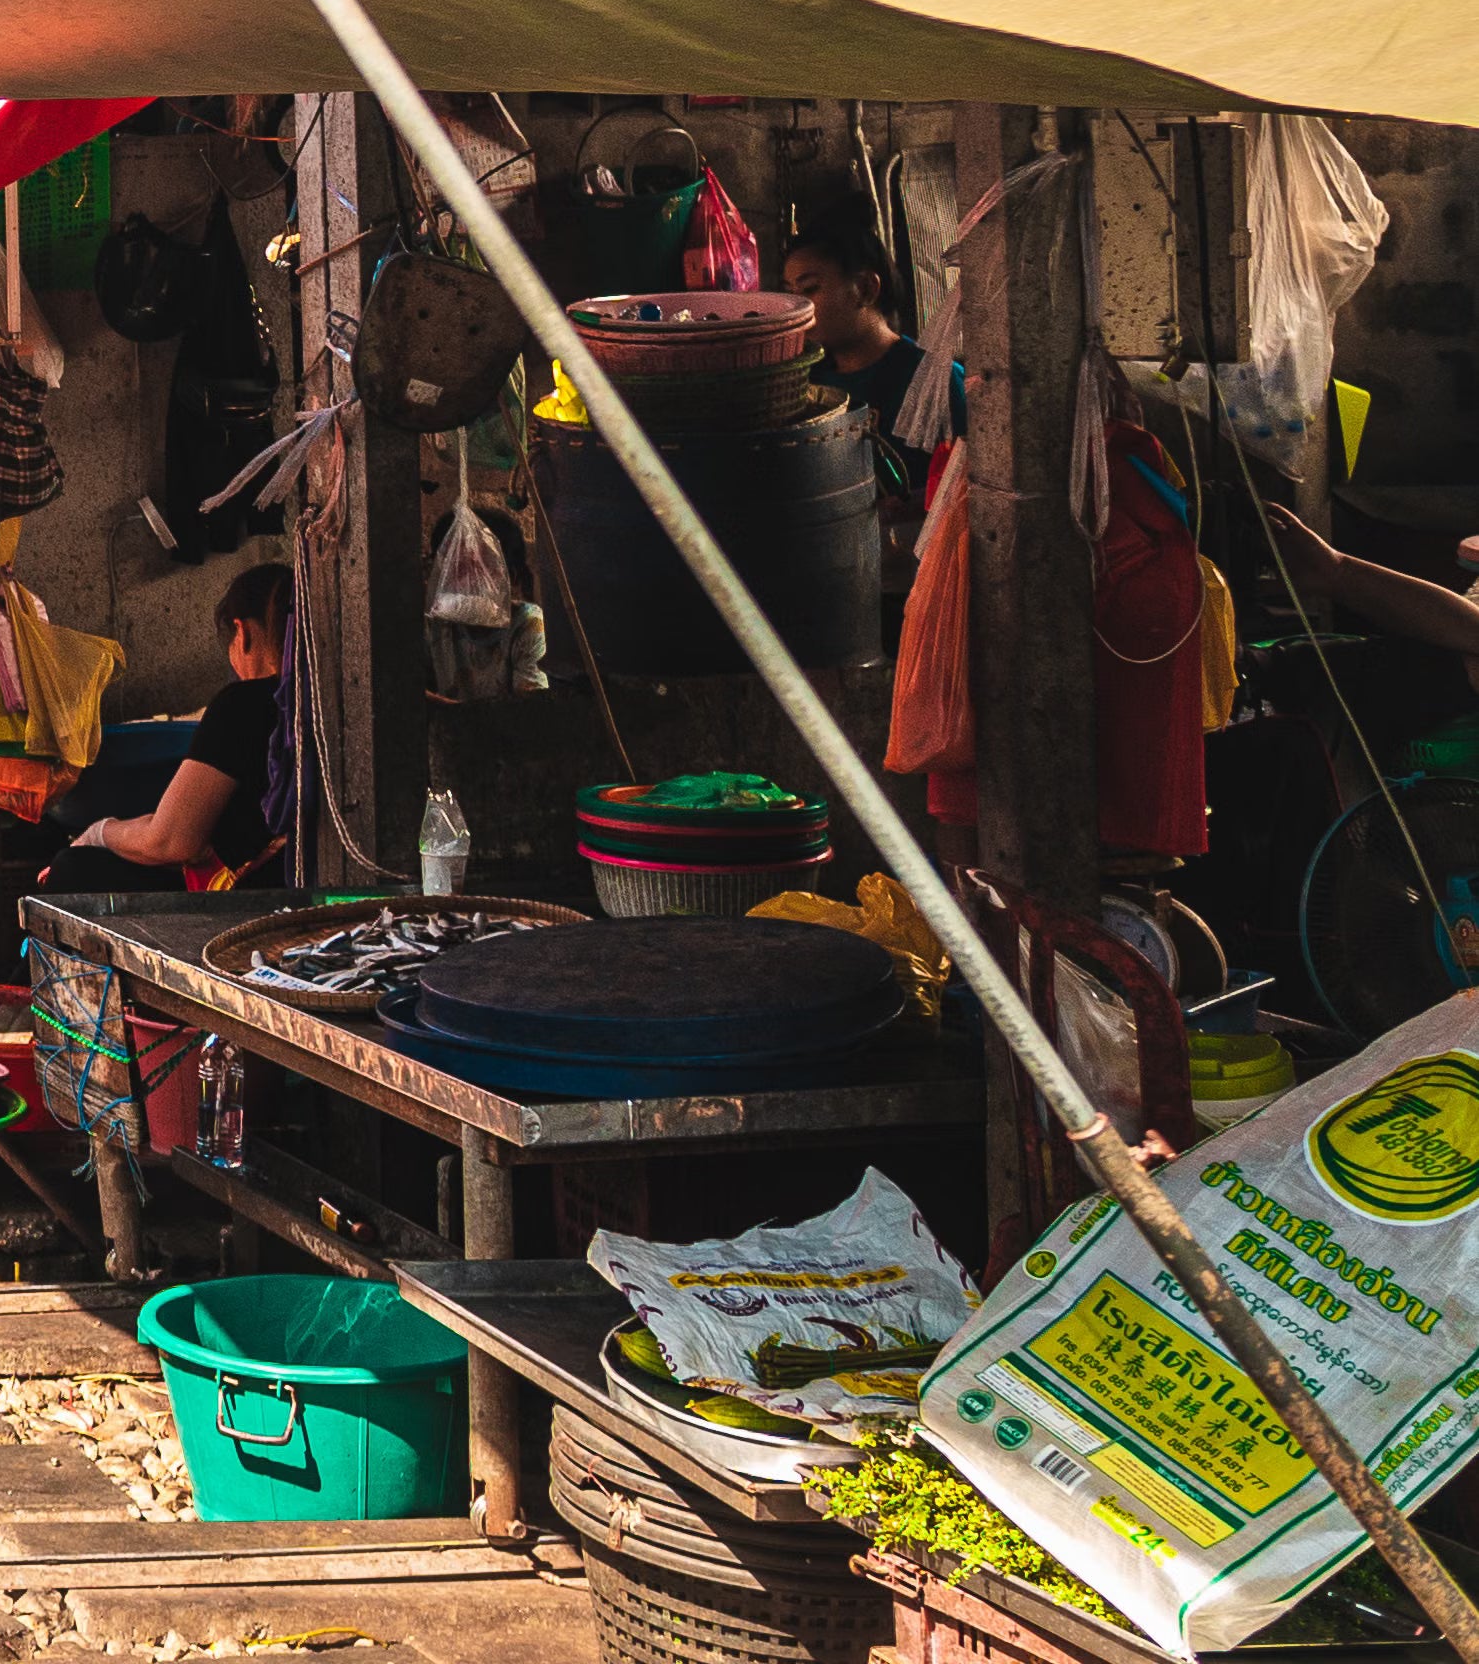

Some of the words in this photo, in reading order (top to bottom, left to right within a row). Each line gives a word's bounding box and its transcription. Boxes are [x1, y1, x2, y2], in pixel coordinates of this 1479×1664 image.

[1375, 1133, 1446, 1177] 481380
[1199, 1160, 1442, 1336] ข้าวเหลืองอ่อน
[1222, 1227, 1353, 1324] ดีพิเศษ
[1079, 1351, 1109, 1380] (034)
[1108, 1369, 1154, 1412] 881-666
[1189, 1433, 1221, 1461] (034)
[1219, 1454, 1270, 1491] 881-777
[1129, 1524, 1165, 1551] 24
